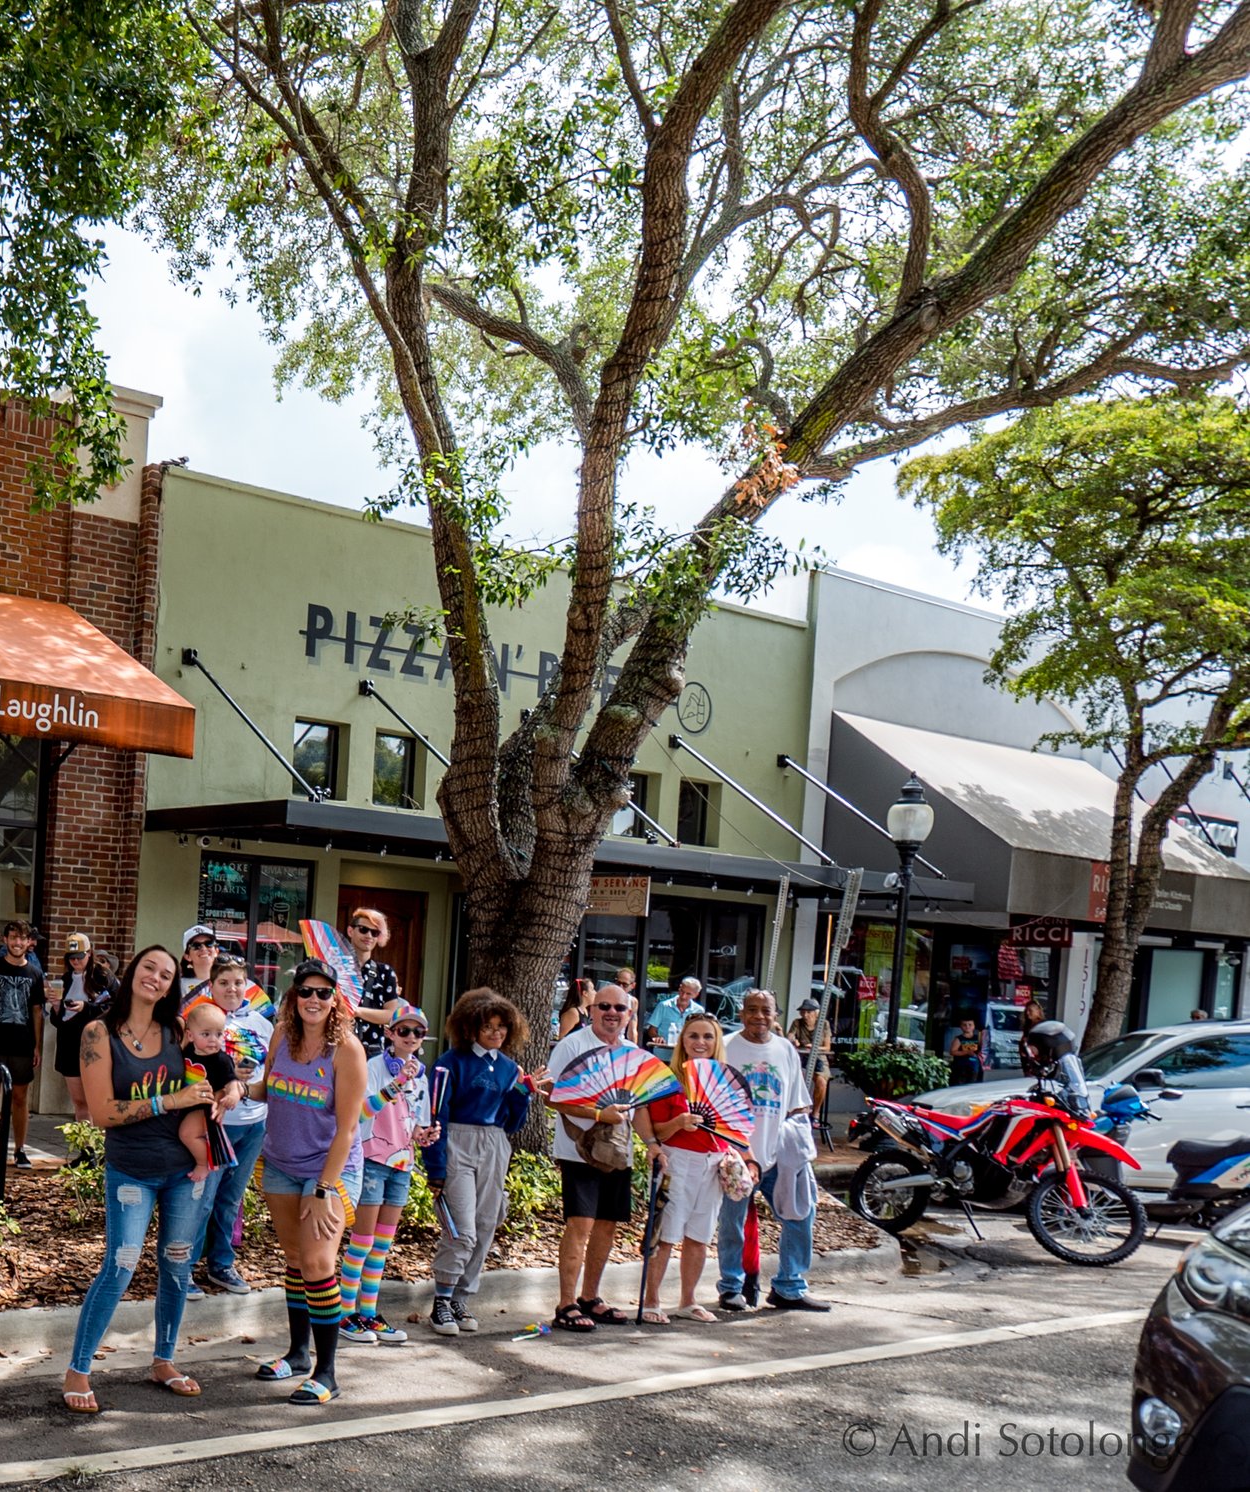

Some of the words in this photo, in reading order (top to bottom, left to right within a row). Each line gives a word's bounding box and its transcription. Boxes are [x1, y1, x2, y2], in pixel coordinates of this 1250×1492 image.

[214, 884, 247, 894] DARTS
[604, 879, 648, 888] SERVING
[1012, 927, 1069, 942] RICCI
[1078, 948, 1089, 1016] 1519
